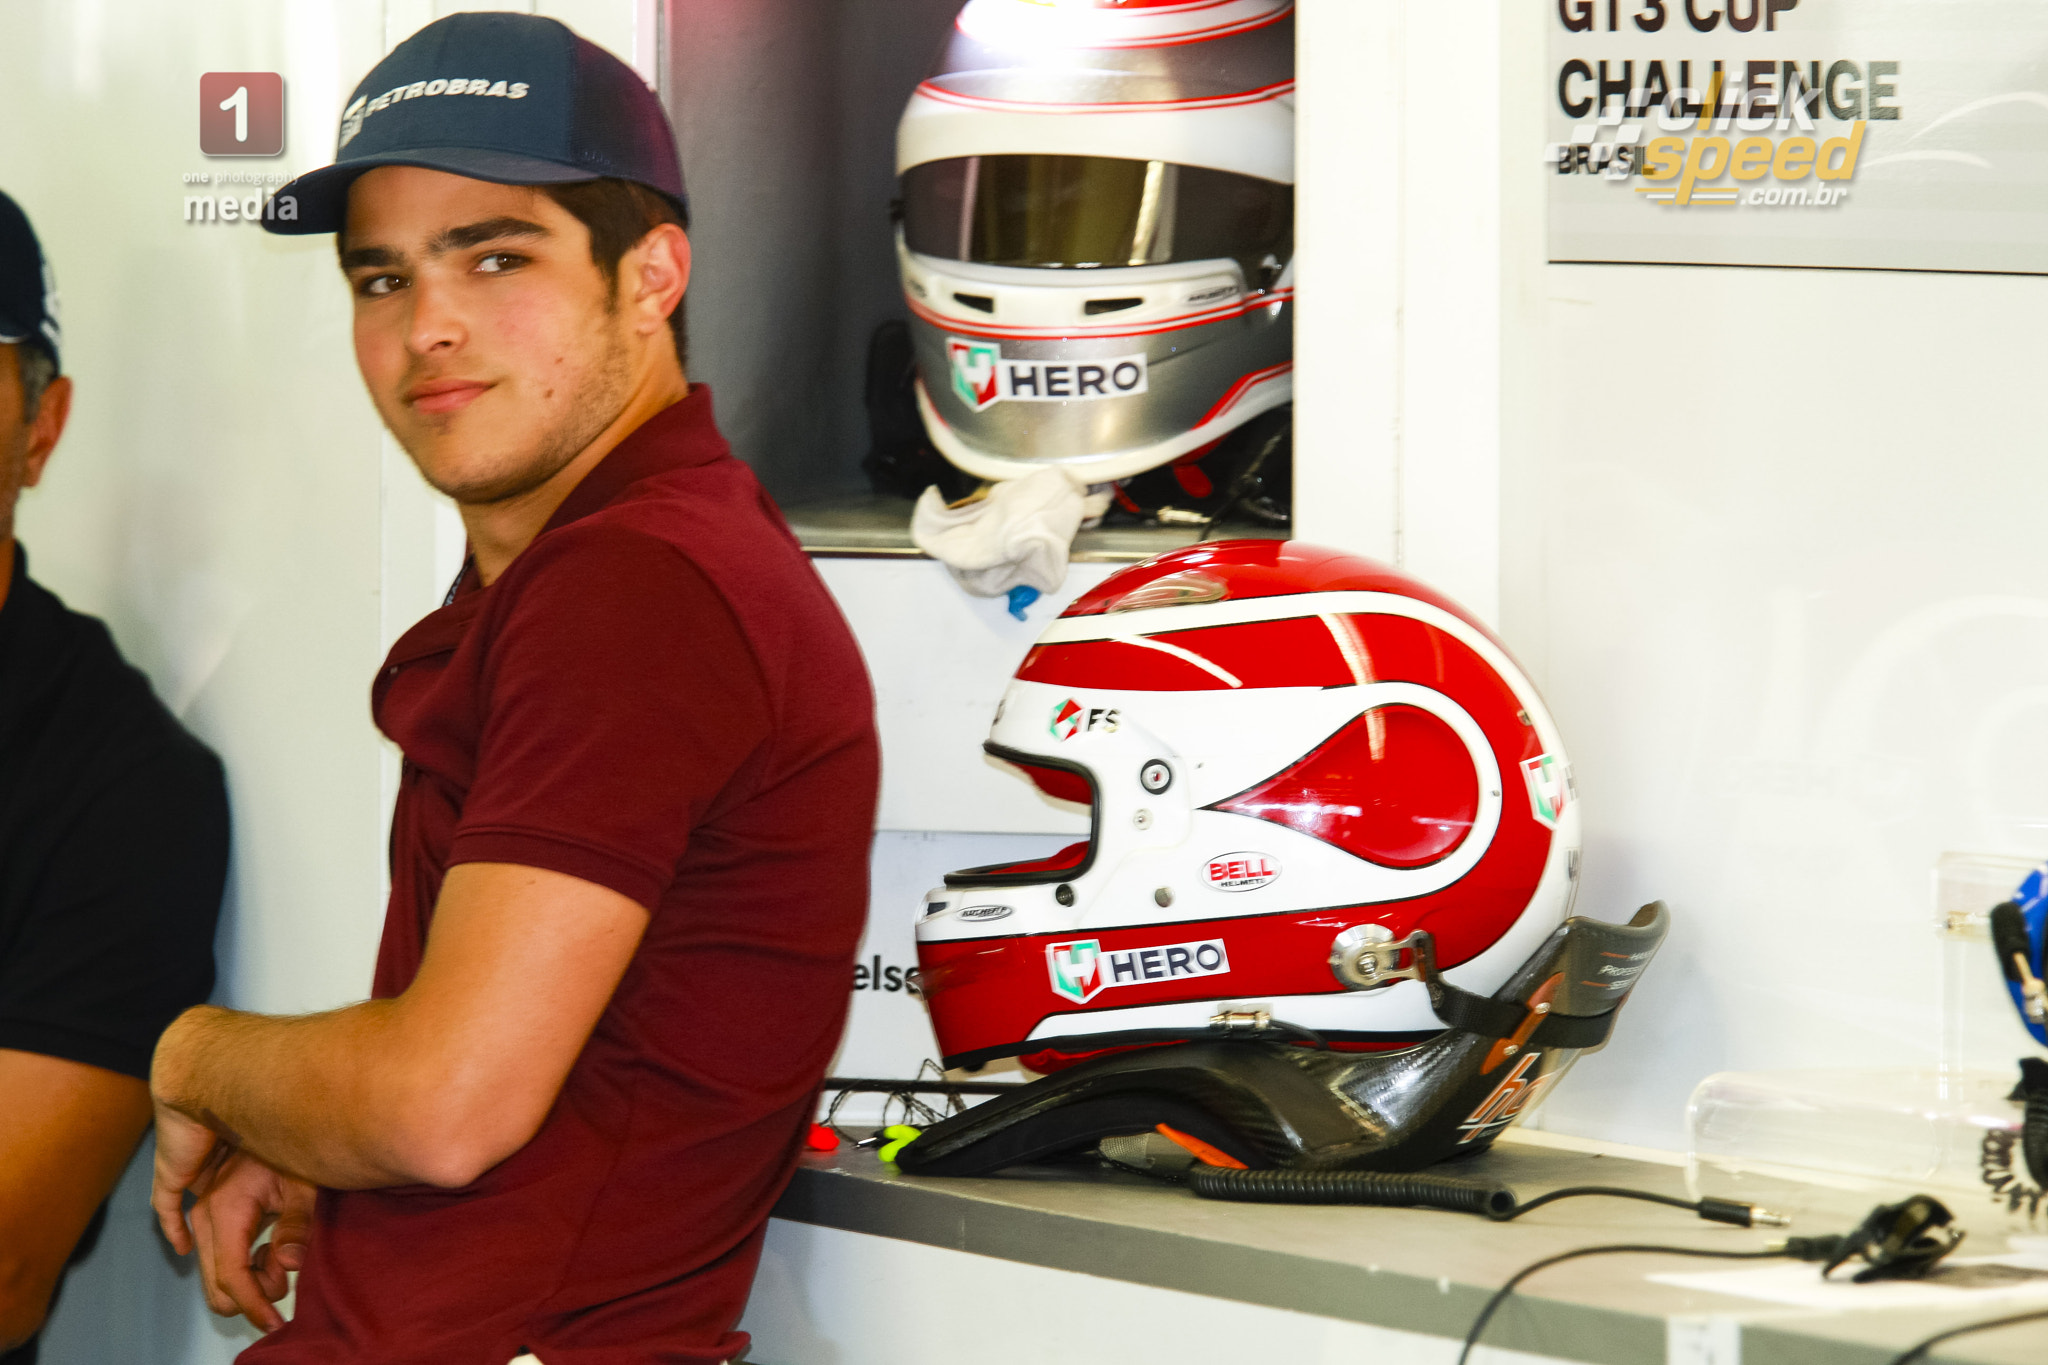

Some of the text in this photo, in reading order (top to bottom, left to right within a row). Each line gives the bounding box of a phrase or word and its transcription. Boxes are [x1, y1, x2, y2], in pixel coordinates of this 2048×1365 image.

[1685, 0, 1799, 32] CUP
[364, 78, 530, 118] PETROBRAS
[1558, 58, 1902, 121] CHALLENGE
[1557, 144, 1656, 175] BRASIL
[1009, 361, 1141, 397] HERO
[1087, 708, 1121, 733] FS
[1209, 859, 1276, 881] BELL
[1110, 943, 1222, 982] HERO
